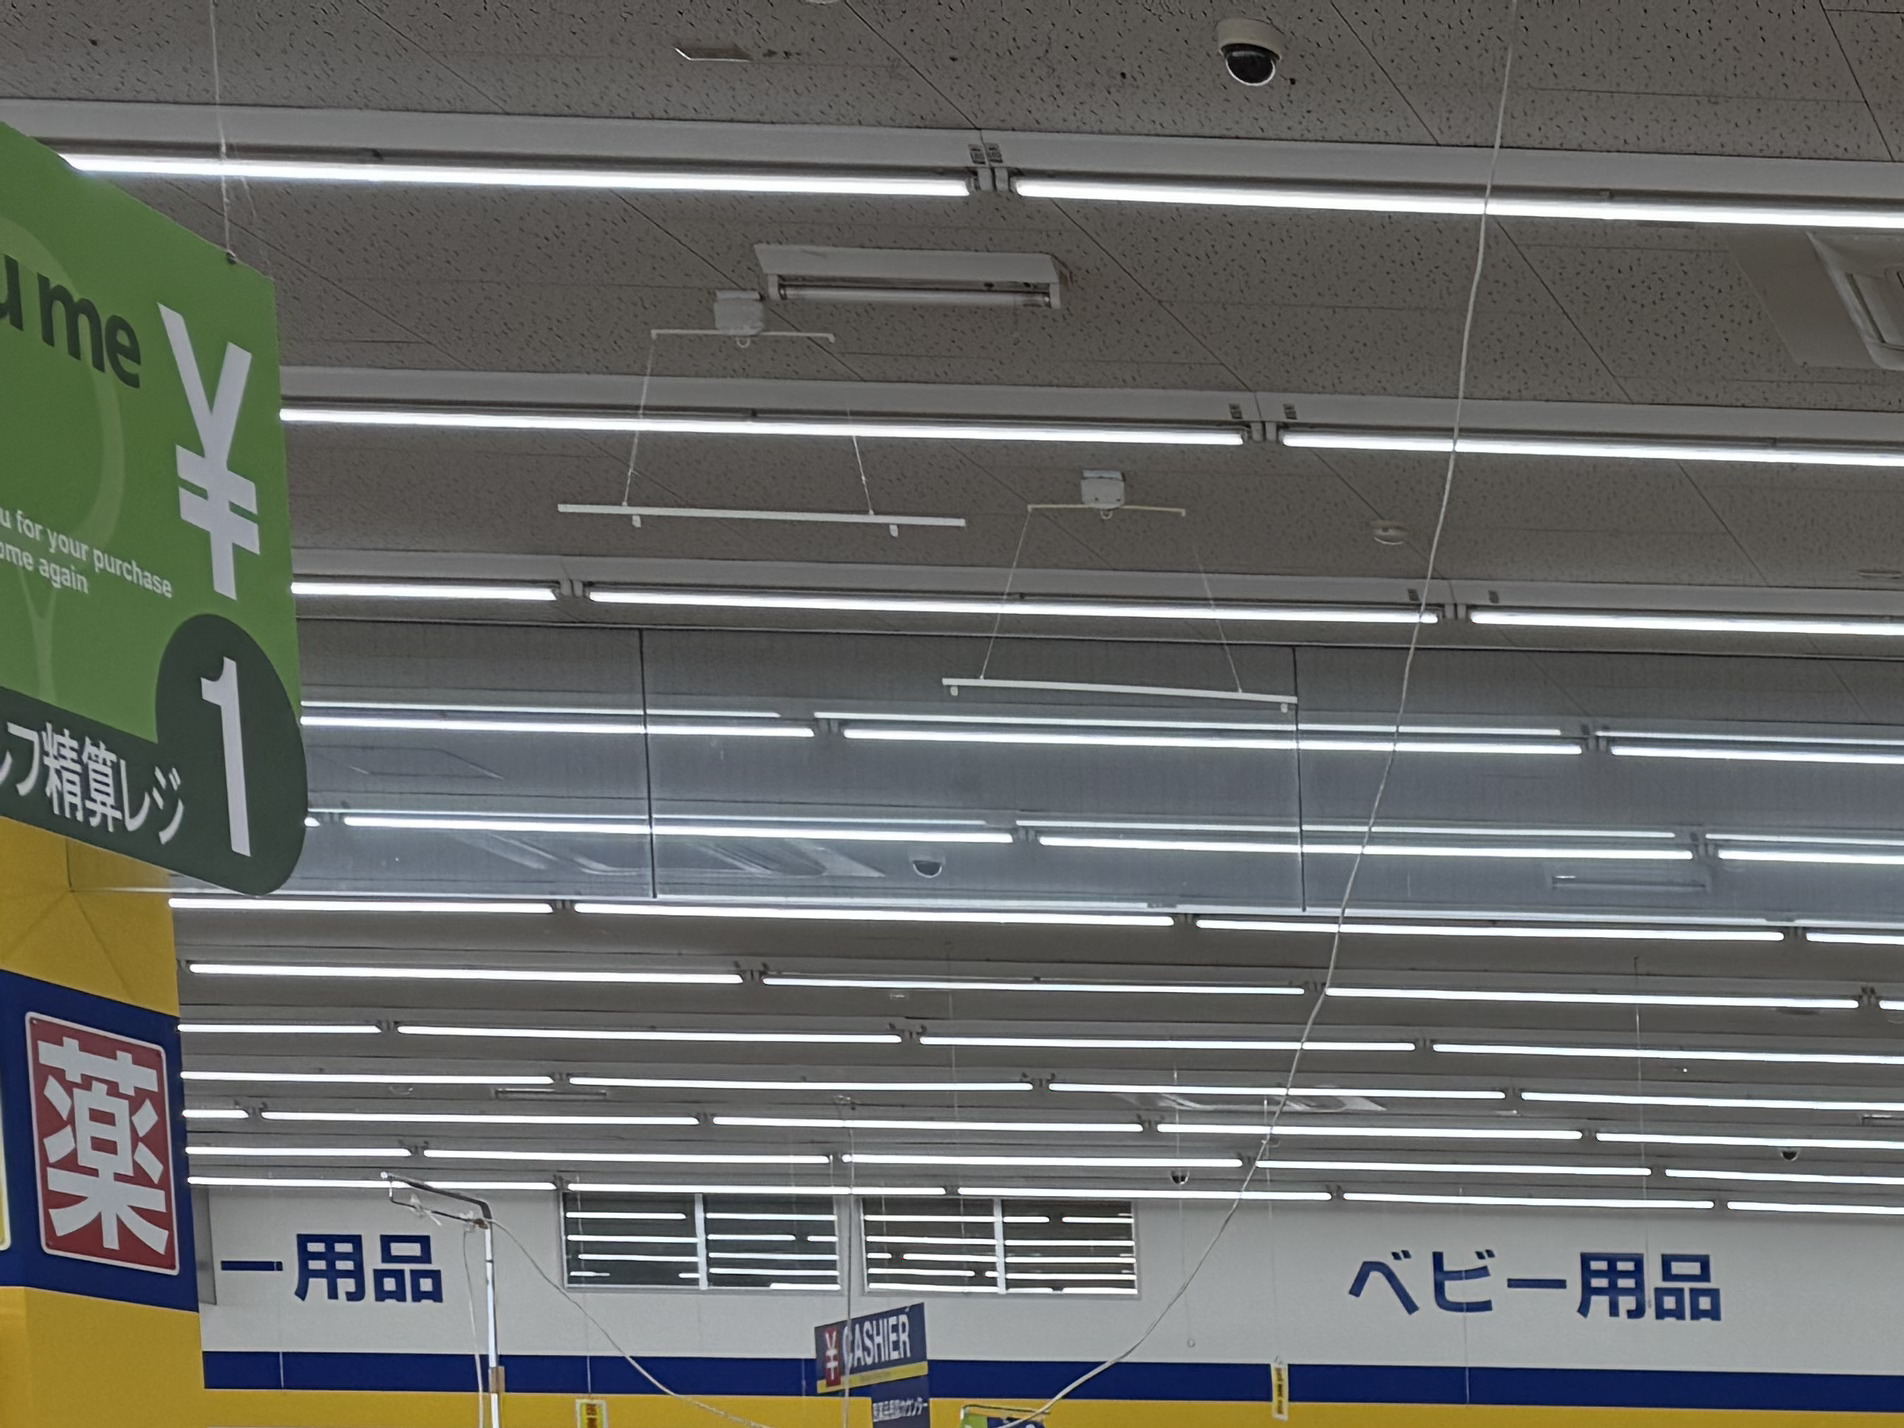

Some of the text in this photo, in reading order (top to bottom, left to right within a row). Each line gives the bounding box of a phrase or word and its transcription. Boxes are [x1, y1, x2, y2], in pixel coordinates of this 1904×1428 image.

[16, 510, 173, 598] for your purchase
[39, 561, 89, 594] again
[38, 1035, 169, 1255] 薬
[1348, 1249, 1721, 1321] ベビー用品
[842, 1311, 911, 1368] CASHIER
